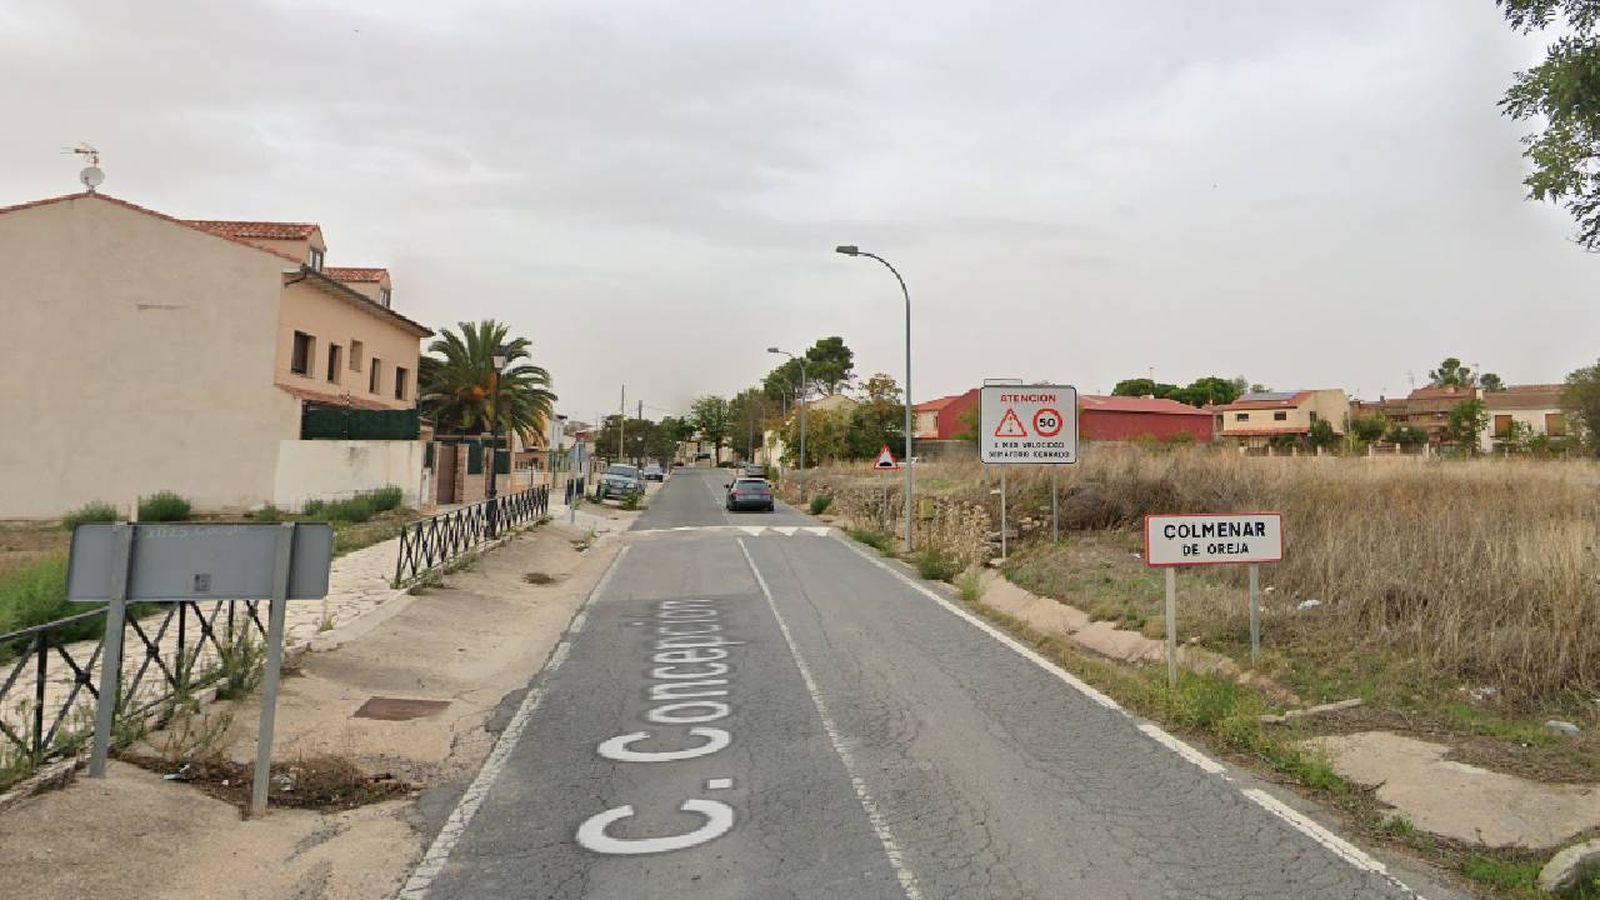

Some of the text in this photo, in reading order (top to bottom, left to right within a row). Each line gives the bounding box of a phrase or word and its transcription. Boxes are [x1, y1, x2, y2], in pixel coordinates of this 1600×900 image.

[1039, 418, 1056, 428] 50
[1164, 522, 1266, 539] COLMENAR
[1183, 542, 1249, 556] DE OREJA
